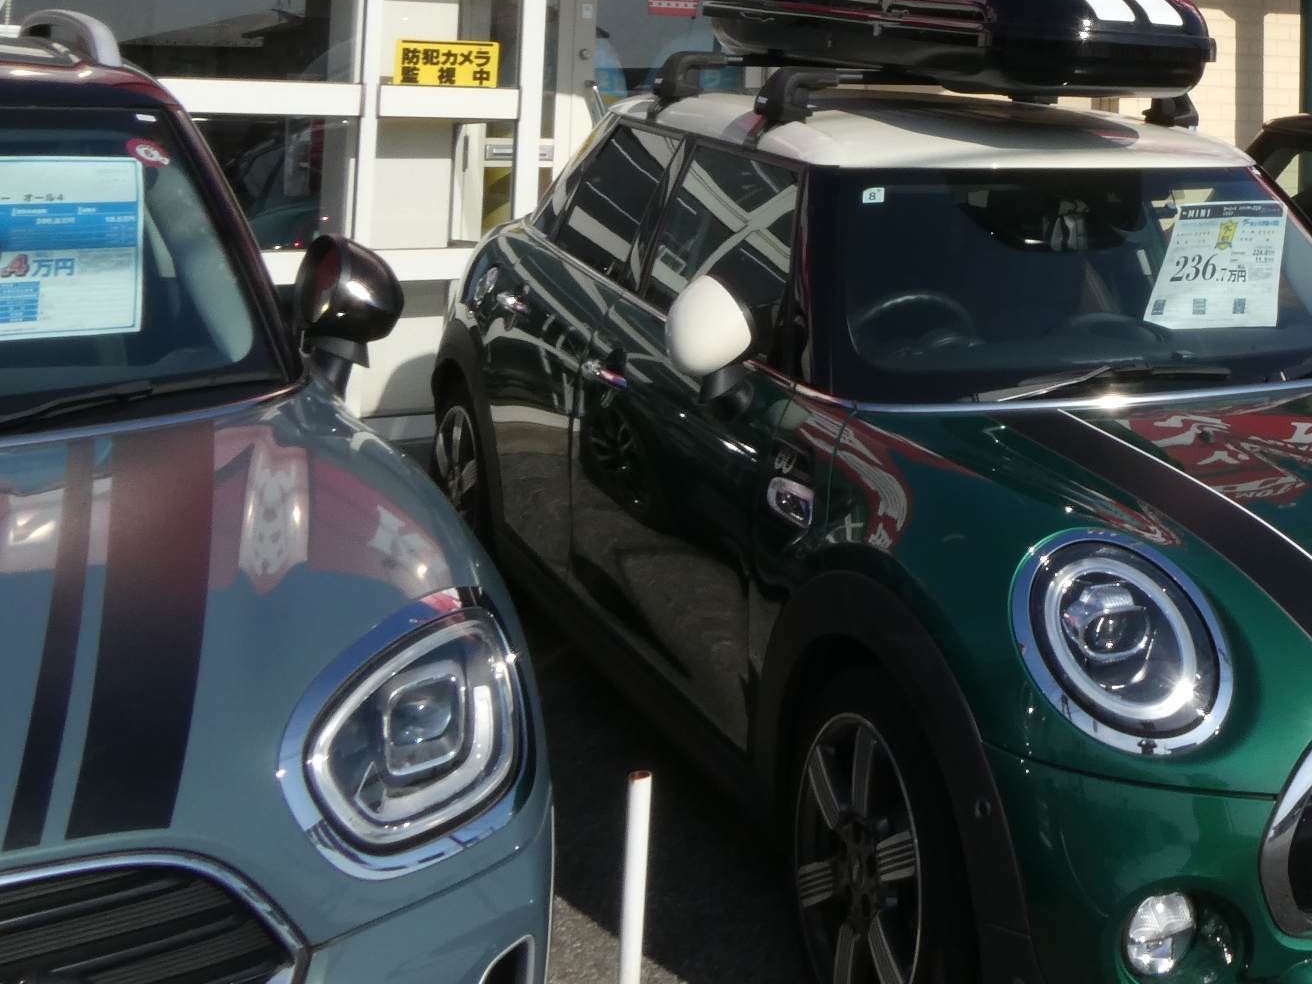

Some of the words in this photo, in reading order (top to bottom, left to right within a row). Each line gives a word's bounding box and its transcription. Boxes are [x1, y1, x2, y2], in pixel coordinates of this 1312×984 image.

[401, 47, 491, 67] 防犯カメラ
[400, 66, 491, 85] 監視中
[1187, 209, 1211, 218] MINI
